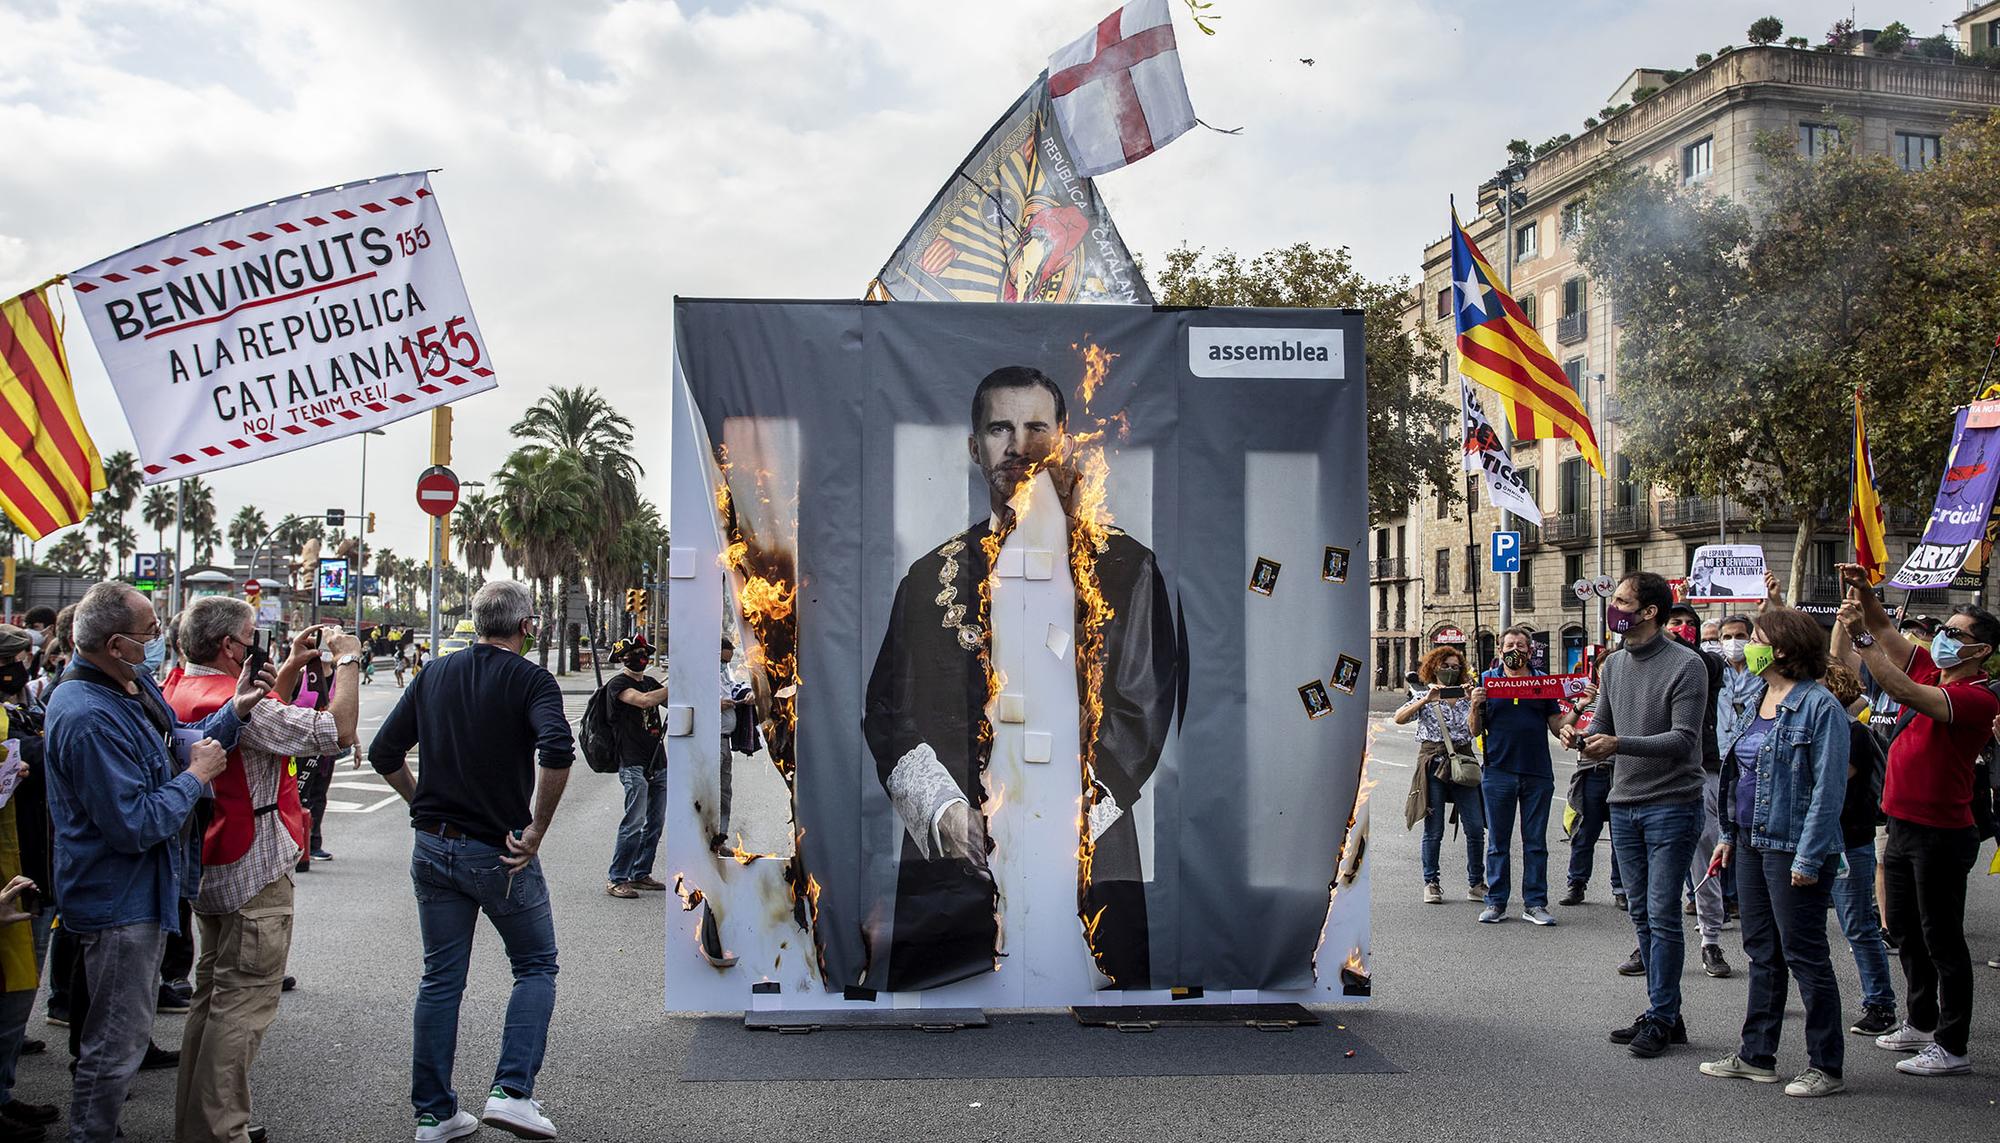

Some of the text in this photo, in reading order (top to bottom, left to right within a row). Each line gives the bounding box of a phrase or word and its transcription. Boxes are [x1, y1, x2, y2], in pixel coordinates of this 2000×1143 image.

[1042, 137, 1088, 209] REPÚBLICA
[105, 223, 430, 341] BENVINGUTS 155
[170, 282, 426, 384] A LA REPÚBLICA
[1208, 341, 1329, 362] assemblea
[213, 315, 481, 421] CATALANA 155
[243, 381, 388, 435] NO! TENIM REI!
[1497, 534, 1515, 556] P
[139, 556, 156, 577] P
[1705, 558, 1714, 567] NO
[1725, 557, 1763, 567] BENVINGUT
[1720, 567, 1763, 576] A CATALUNYA
[1487, 679, 1541, 688] CATALUNYA
